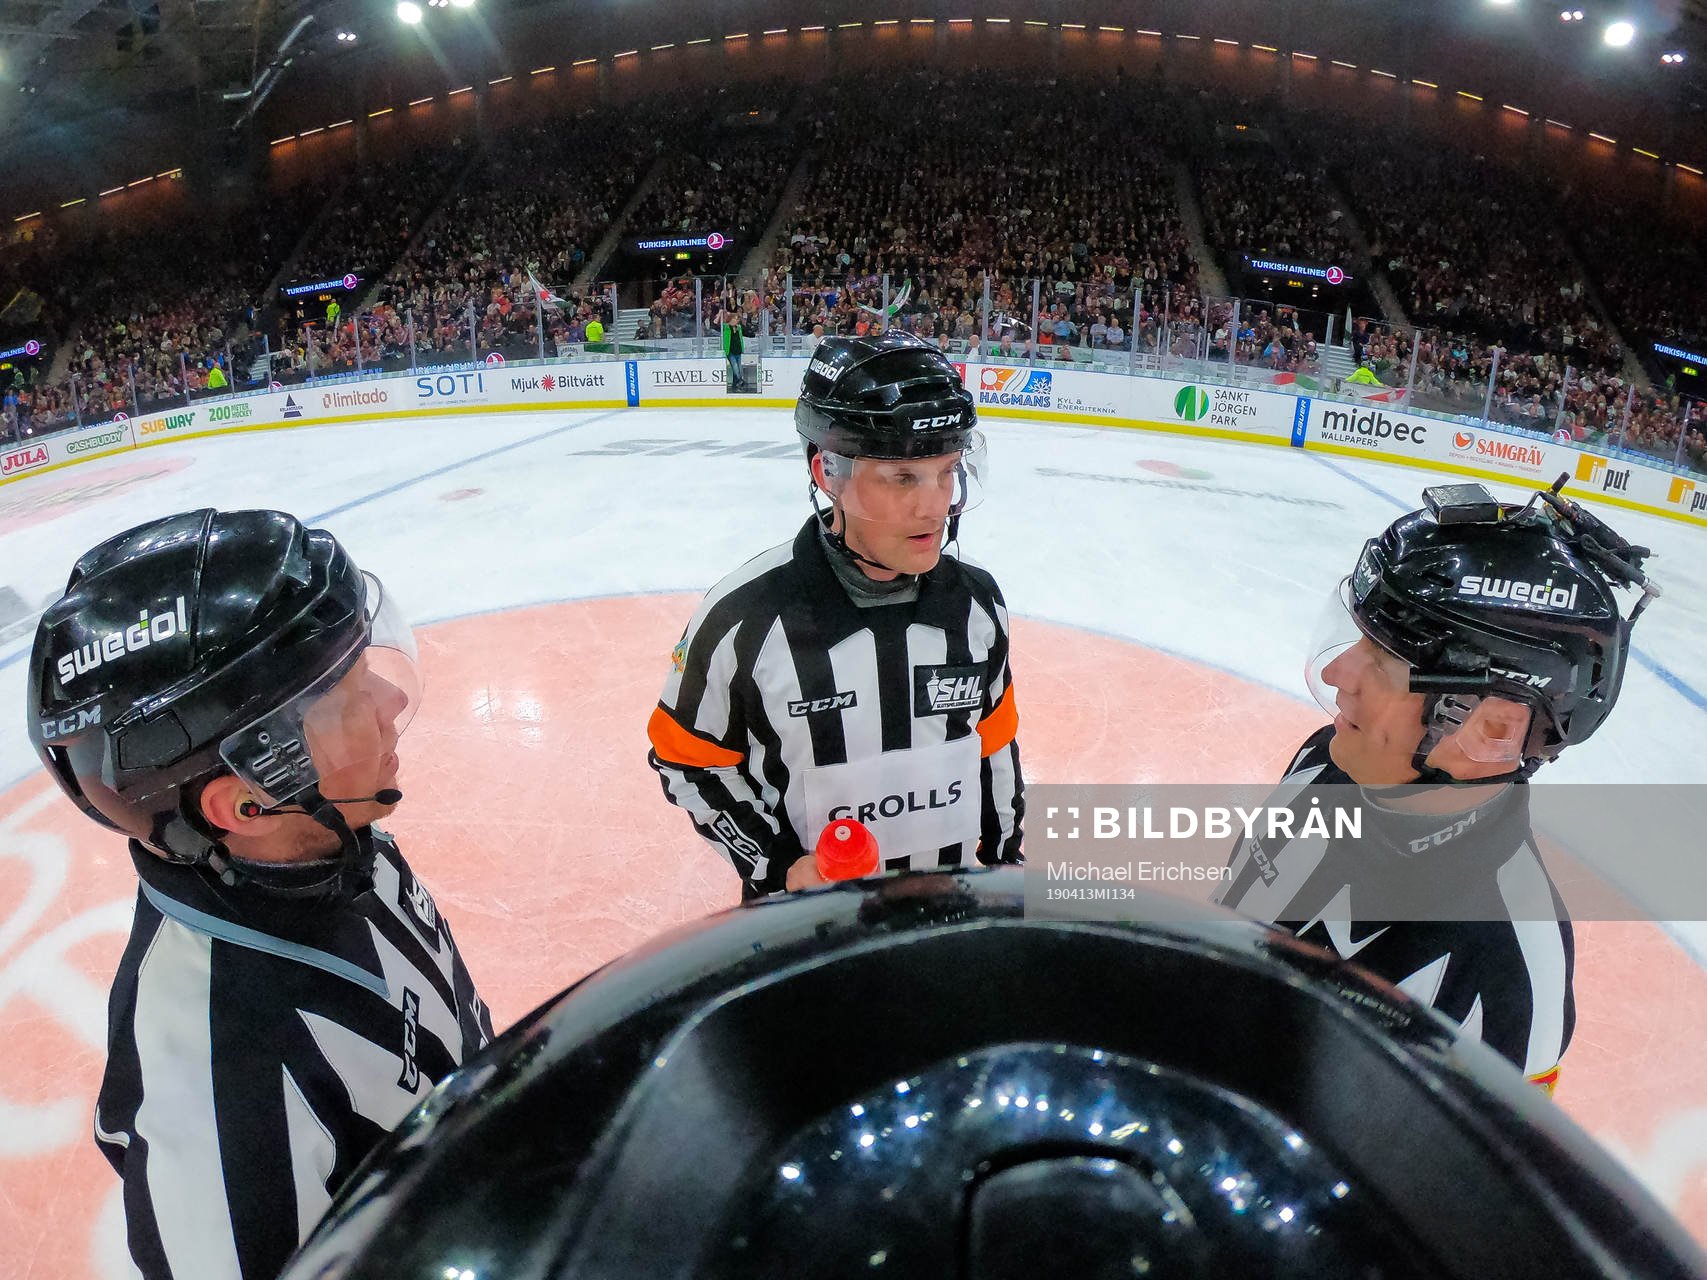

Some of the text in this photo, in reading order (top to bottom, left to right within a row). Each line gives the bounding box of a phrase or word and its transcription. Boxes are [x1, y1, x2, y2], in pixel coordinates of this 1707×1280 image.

[638, 239, 706, 249] TURKISH AIRLINES
[1252, 260, 1326, 277] TURKISH AIRLINES
[287, 280, 343, 295] TURKISH AIRLINES
[1654, 343, 1686, 358] TURKISH
[652, 370, 707, 384] TRAVEL
[810, 358, 845, 381] wedol
[417, 372, 484, 398] SOTI
[511, 374, 605, 393] Mjuk Biltvätt
[333, 387, 388, 408] limitado
[980, 391, 1051, 408] HAGMANS
[1057, 397, 1074, 405] KYL
[1214, 389, 1250, 403] SANKT
[209, 405, 231, 422] 200
[231, 403, 249, 412] METER
[232, 409, 252, 418] HOCKEY
[1057, 404, 1117, 414] ENERGITEKNIK
[1212, 401, 1257, 417] JÖRGEN
[140, 411, 196, 435] SUBWAY
[912, 413, 962, 430] CCM
[1210, 415, 1238, 426] PARK
[1322, 408, 1428, 445] midbec
[67, 430, 123, 454] CASHBUDDY
[1321, 431, 1379, 448] WALLPAPERS
[3, 448, 48, 471] JULA
[1476, 438, 1546, 466] SAMGRÄV
[1603, 469, 1630, 491] put
[1690, 491, 1707, 513] pu
[1458, 575, 1580, 610] swedol
[57, 596, 188, 685] swedol
[1490, 667, 1552, 688] CM
[935, 675, 983, 702] SHL
[790, 694, 855, 716] CCM
[40, 706, 102, 739] CCM
[828, 780, 962, 825] GROLLS
[716, 816, 762, 862] CC
[1408, 809, 1479, 854] CCM
[1250, 838, 1276, 880] CCM
[403, 994, 417, 1088] CCM
